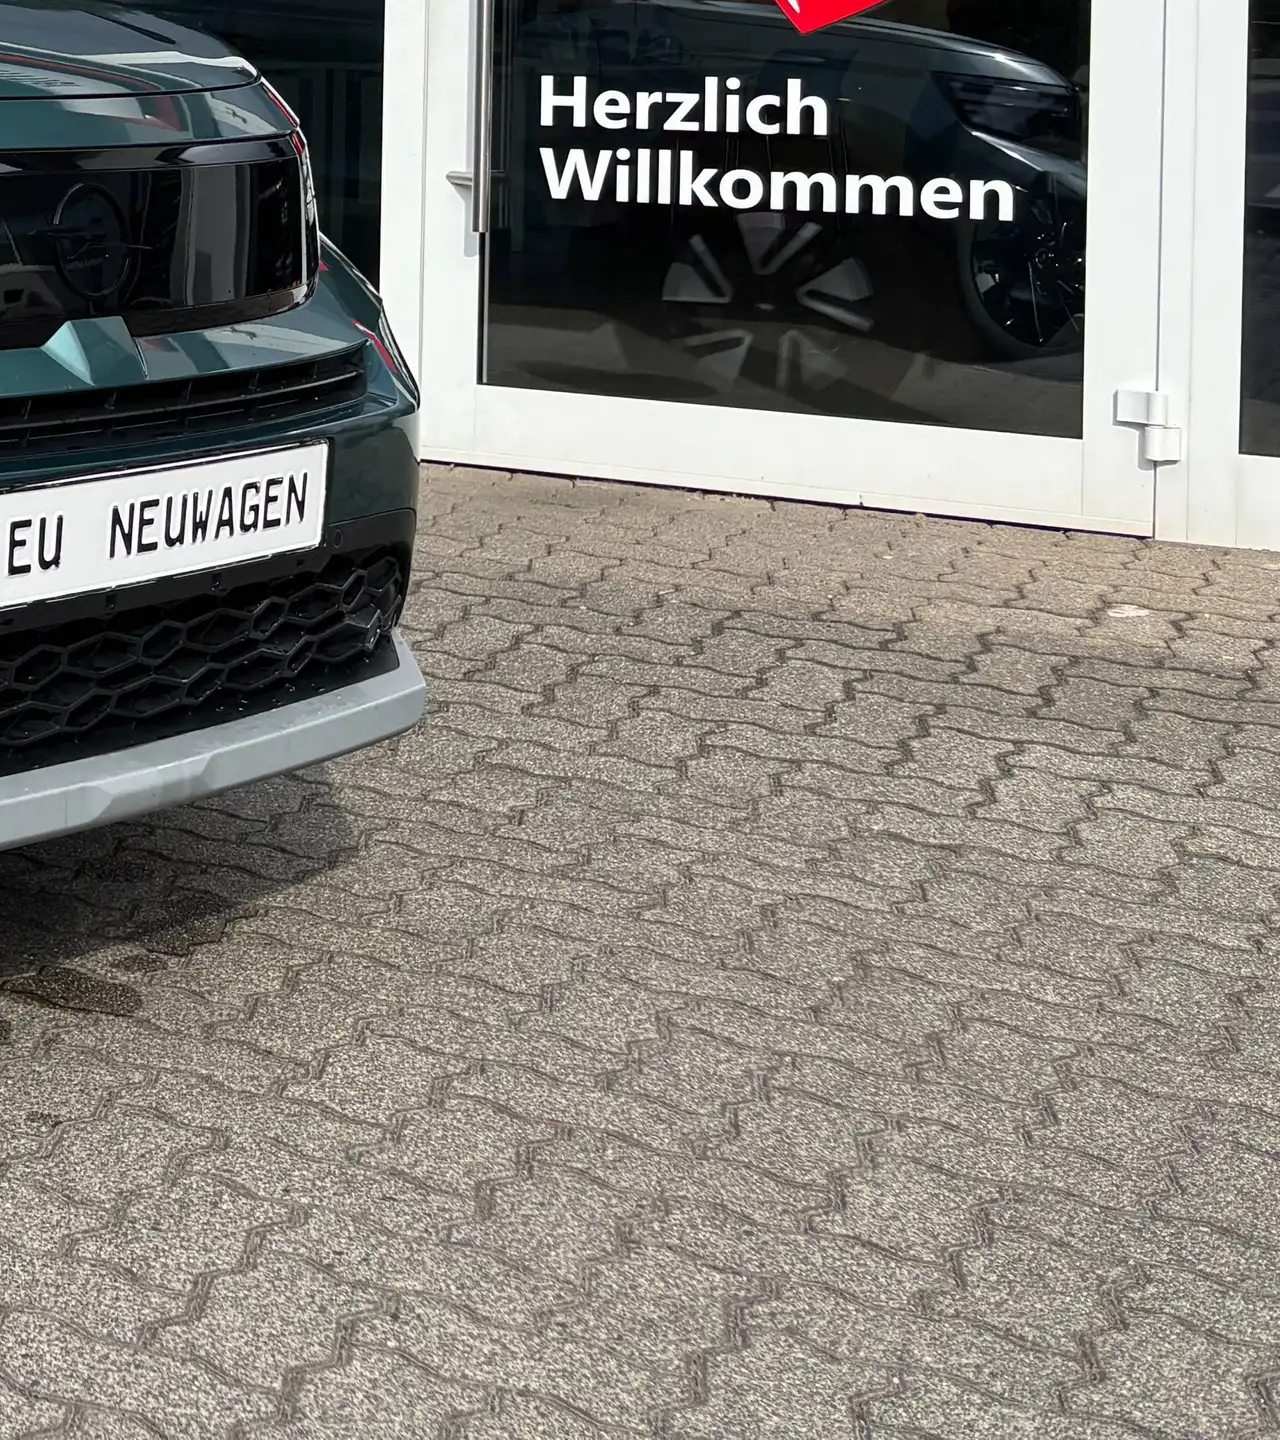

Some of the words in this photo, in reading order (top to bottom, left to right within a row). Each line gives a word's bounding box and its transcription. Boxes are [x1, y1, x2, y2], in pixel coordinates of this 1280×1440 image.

[540, 75, 828, 136] Herzlich
[539, 147, 1015, 222] Willkommen
[7, 515, 64, 576] EU
[109, 472, 309, 559] NEUWAGEN
